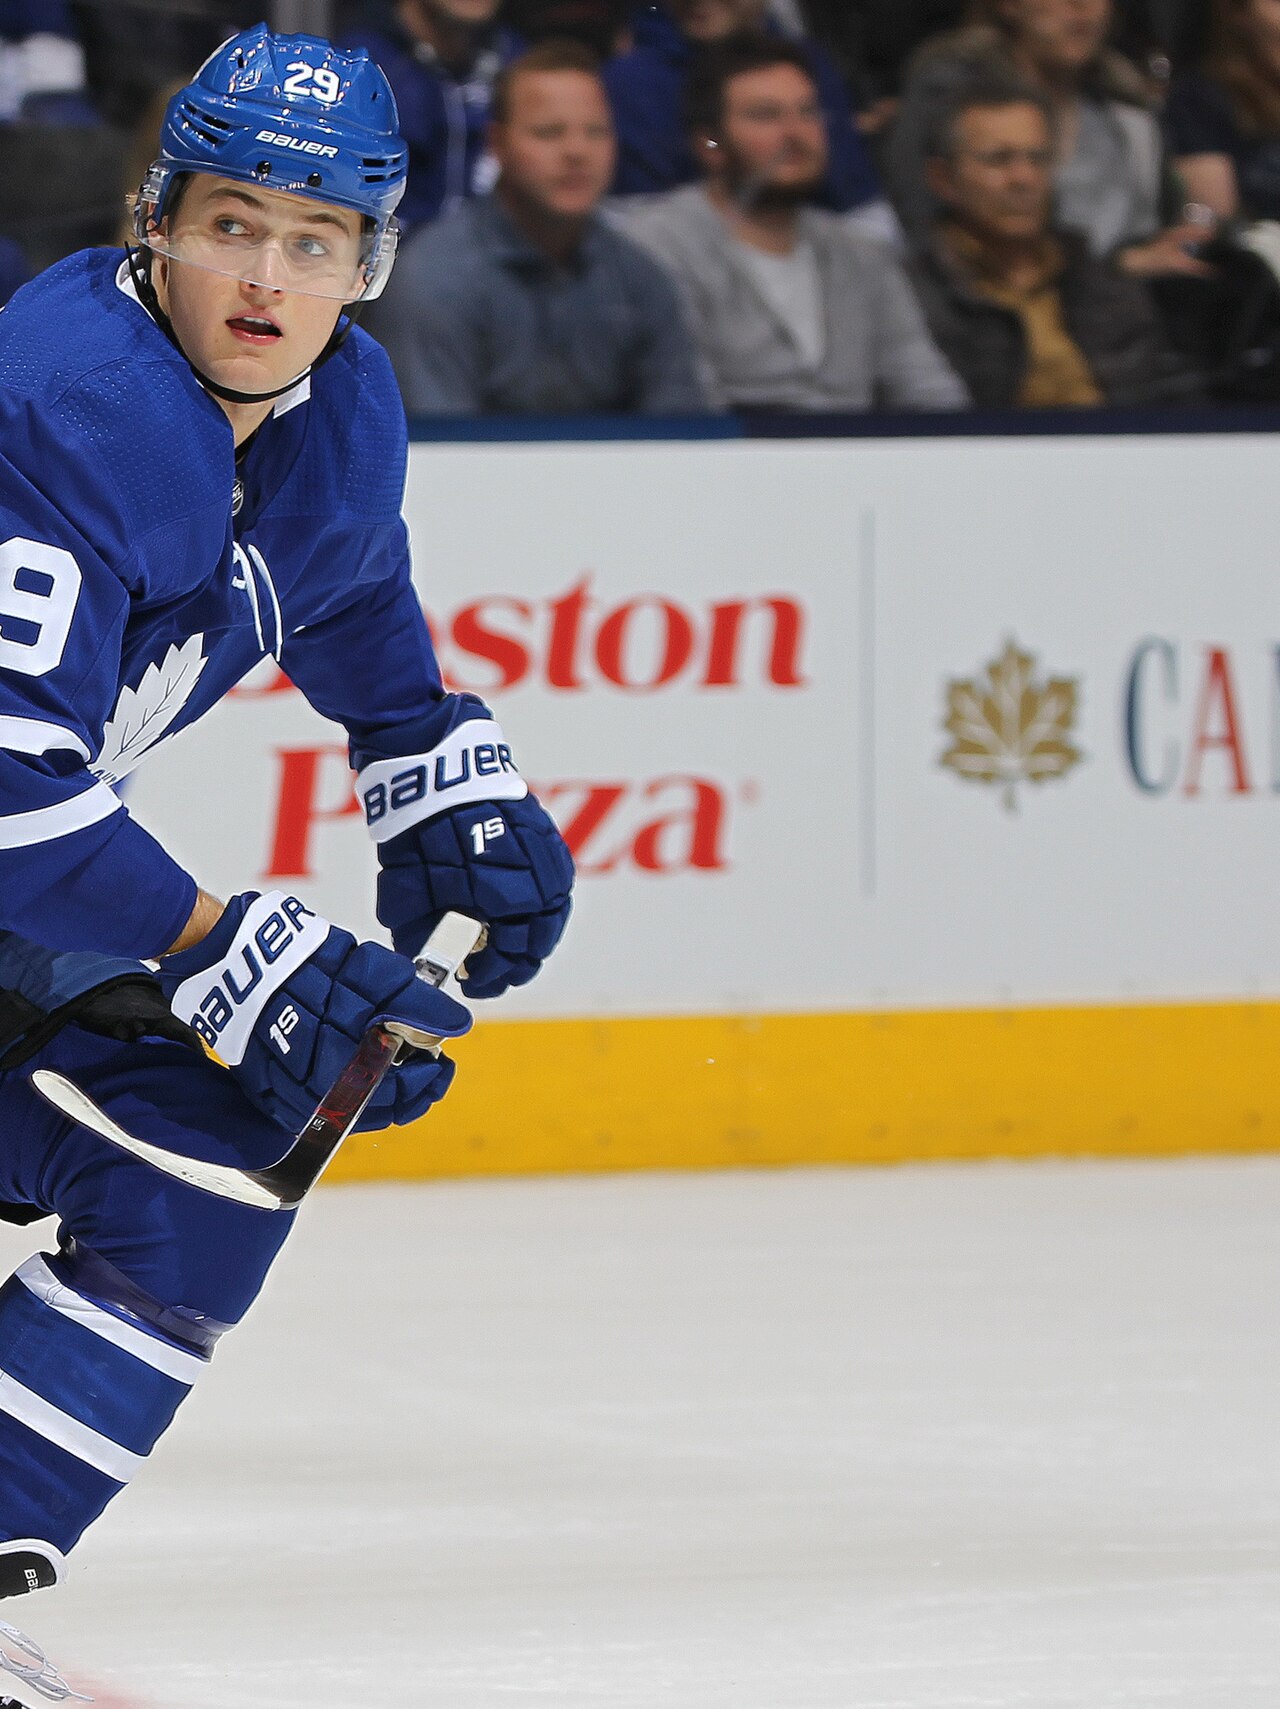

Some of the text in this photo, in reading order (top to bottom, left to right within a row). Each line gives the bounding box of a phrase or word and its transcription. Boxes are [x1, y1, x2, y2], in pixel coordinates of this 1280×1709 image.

[283, 61, 340, 103] 29
[255, 130, 339, 158] BAUER
[1123, 632, 1280, 800] CA
[364, 743, 518, 826] BAUER
[190, 896, 317, 1048] BAUER
